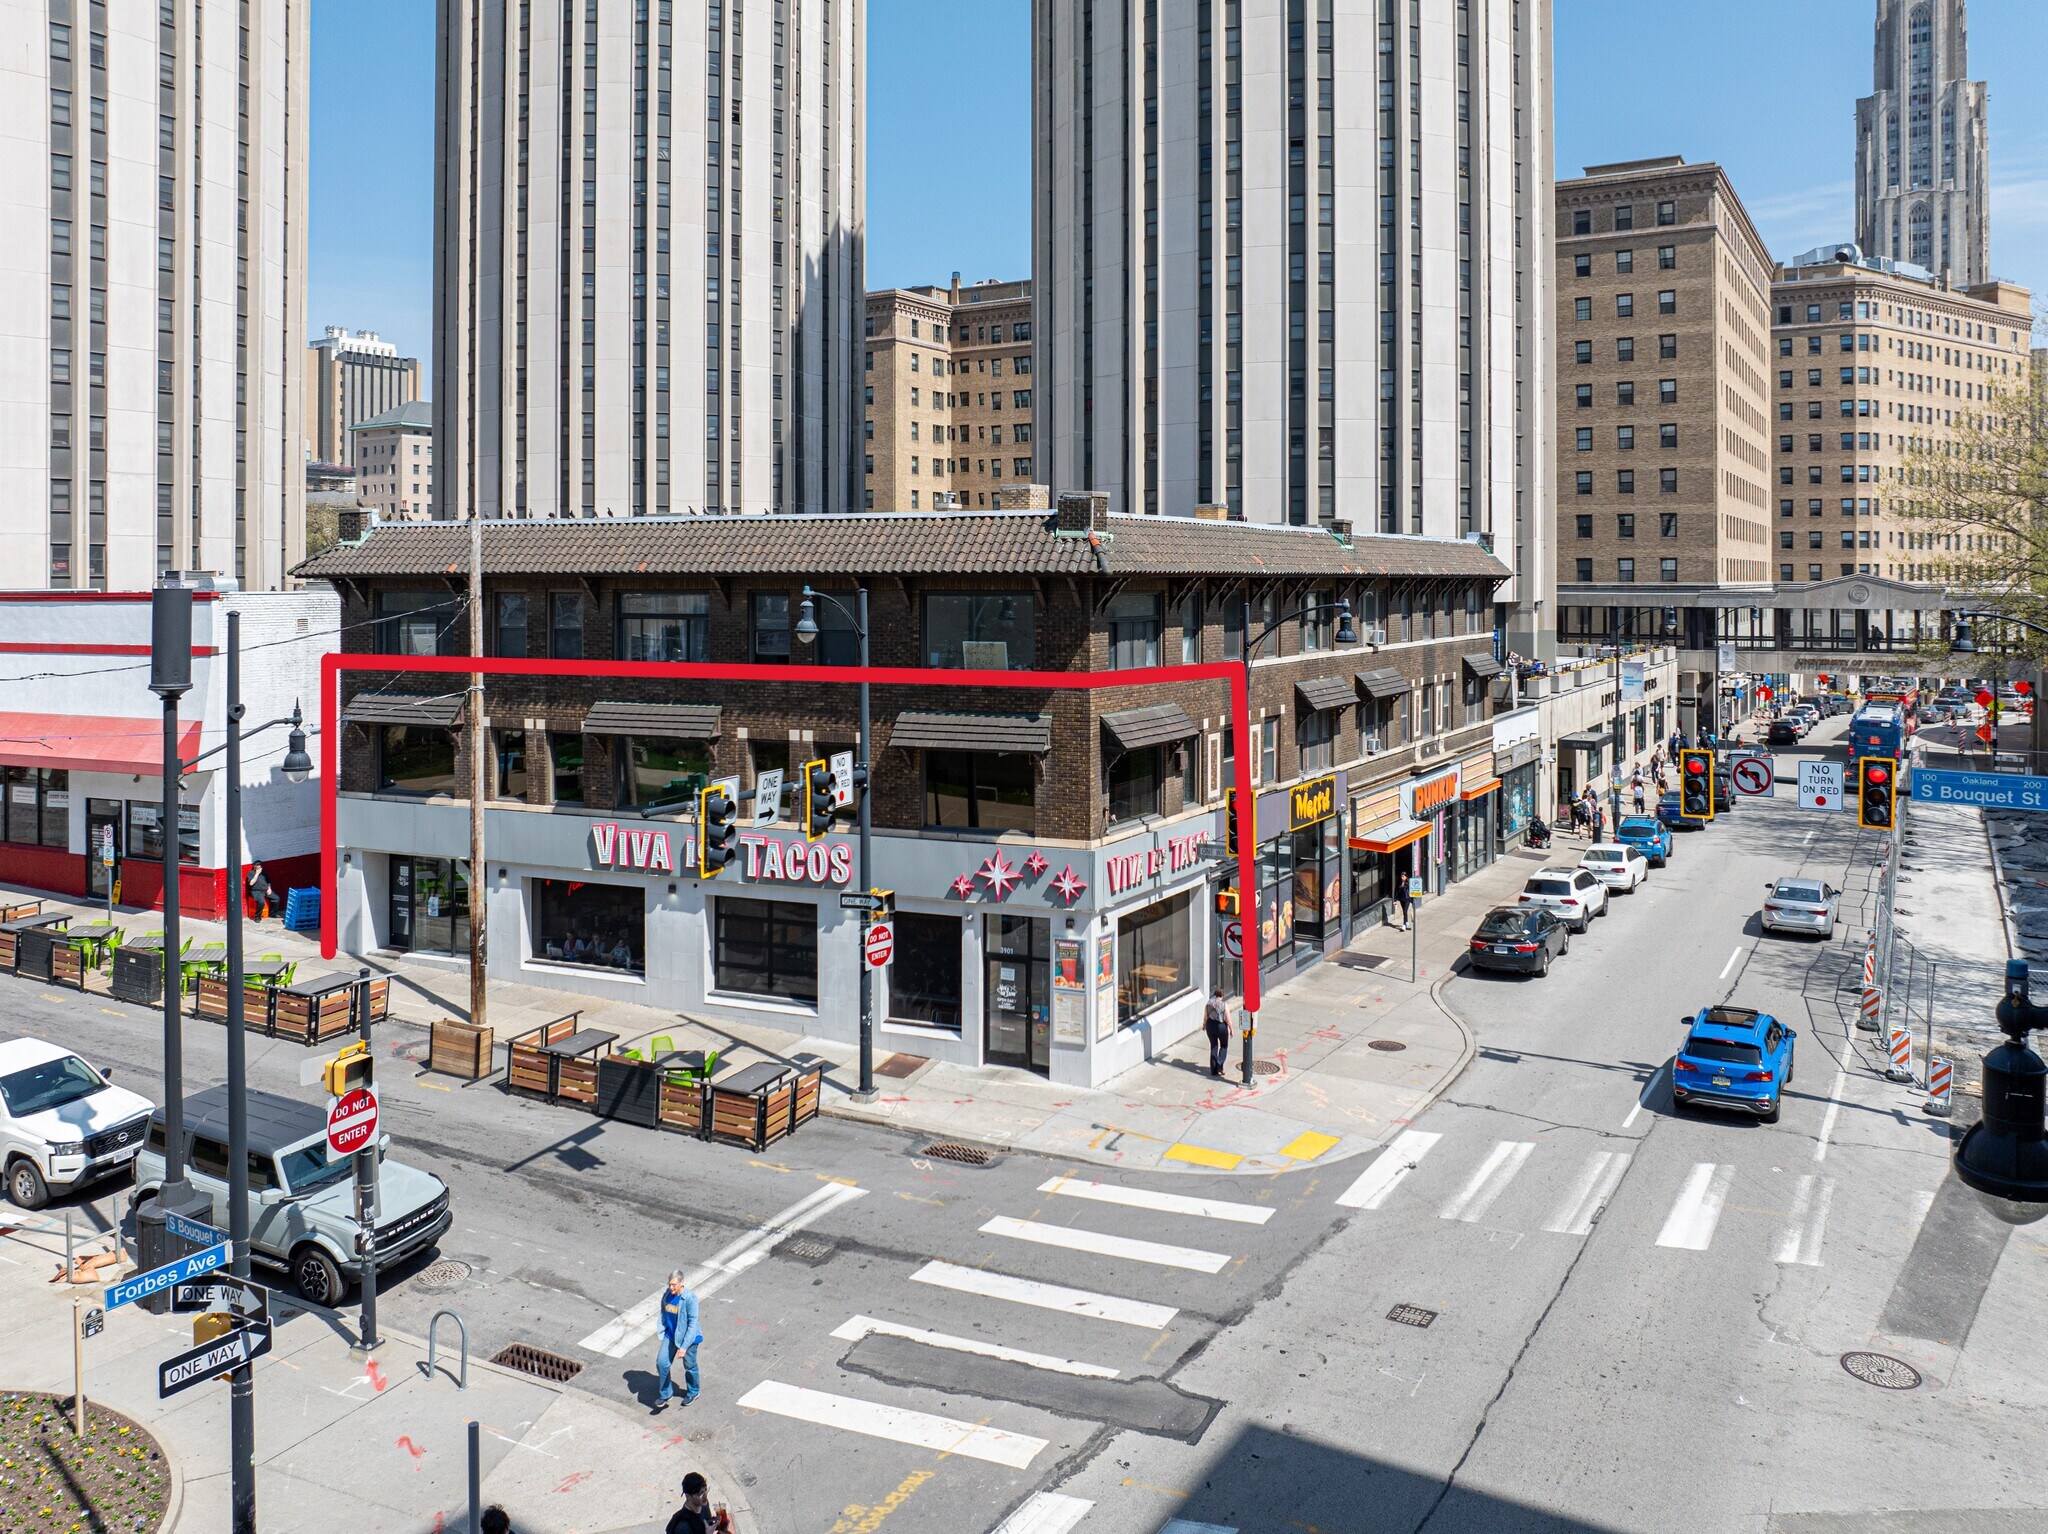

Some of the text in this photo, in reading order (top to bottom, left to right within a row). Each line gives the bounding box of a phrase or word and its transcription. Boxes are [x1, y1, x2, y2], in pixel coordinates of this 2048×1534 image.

[836, 757, 846, 768] NO
[1811, 765, 1830, 775] NO
[762, 775, 778, 790] ONE
[840, 779, 850, 789] RED
[1808, 775, 1834, 785] TURN
[1921, 773, 2042, 789] 100 Oakland 200
[760, 790, 777, 805] WAY
[1416, 772, 1457, 815] DUNKIN'
[1802, 784, 1839, 795] ON RED
[1921, 784, 2042, 806] S Bouquet St
[592, 823, 674, 871] VIVA
[739, 834, 854, 884] TACOS
[1201, 847, 1226, 856] ONE WA
[1107, 852, 1144, 893] VIVA
[869, 931, 889, 943] DO NOT
[871, 949, 888, 961] ENTER
[1000, 946, 1014, 955] 3901
[335, 1096, 371, 1119] DO NOT
[338, 1125, 368, 1145] ENTER
[388, 1208, 435, 1237] BRONCO
[168, 1216, 176, 1230] S
[178, 1220, 213, 1246] Bouquet
[113, 1253, 217, 1304] Forbes Ave
[182, 1286, 243, 1305] ONE WAY
[169, 1342, 238, 1383] ONE WAY
